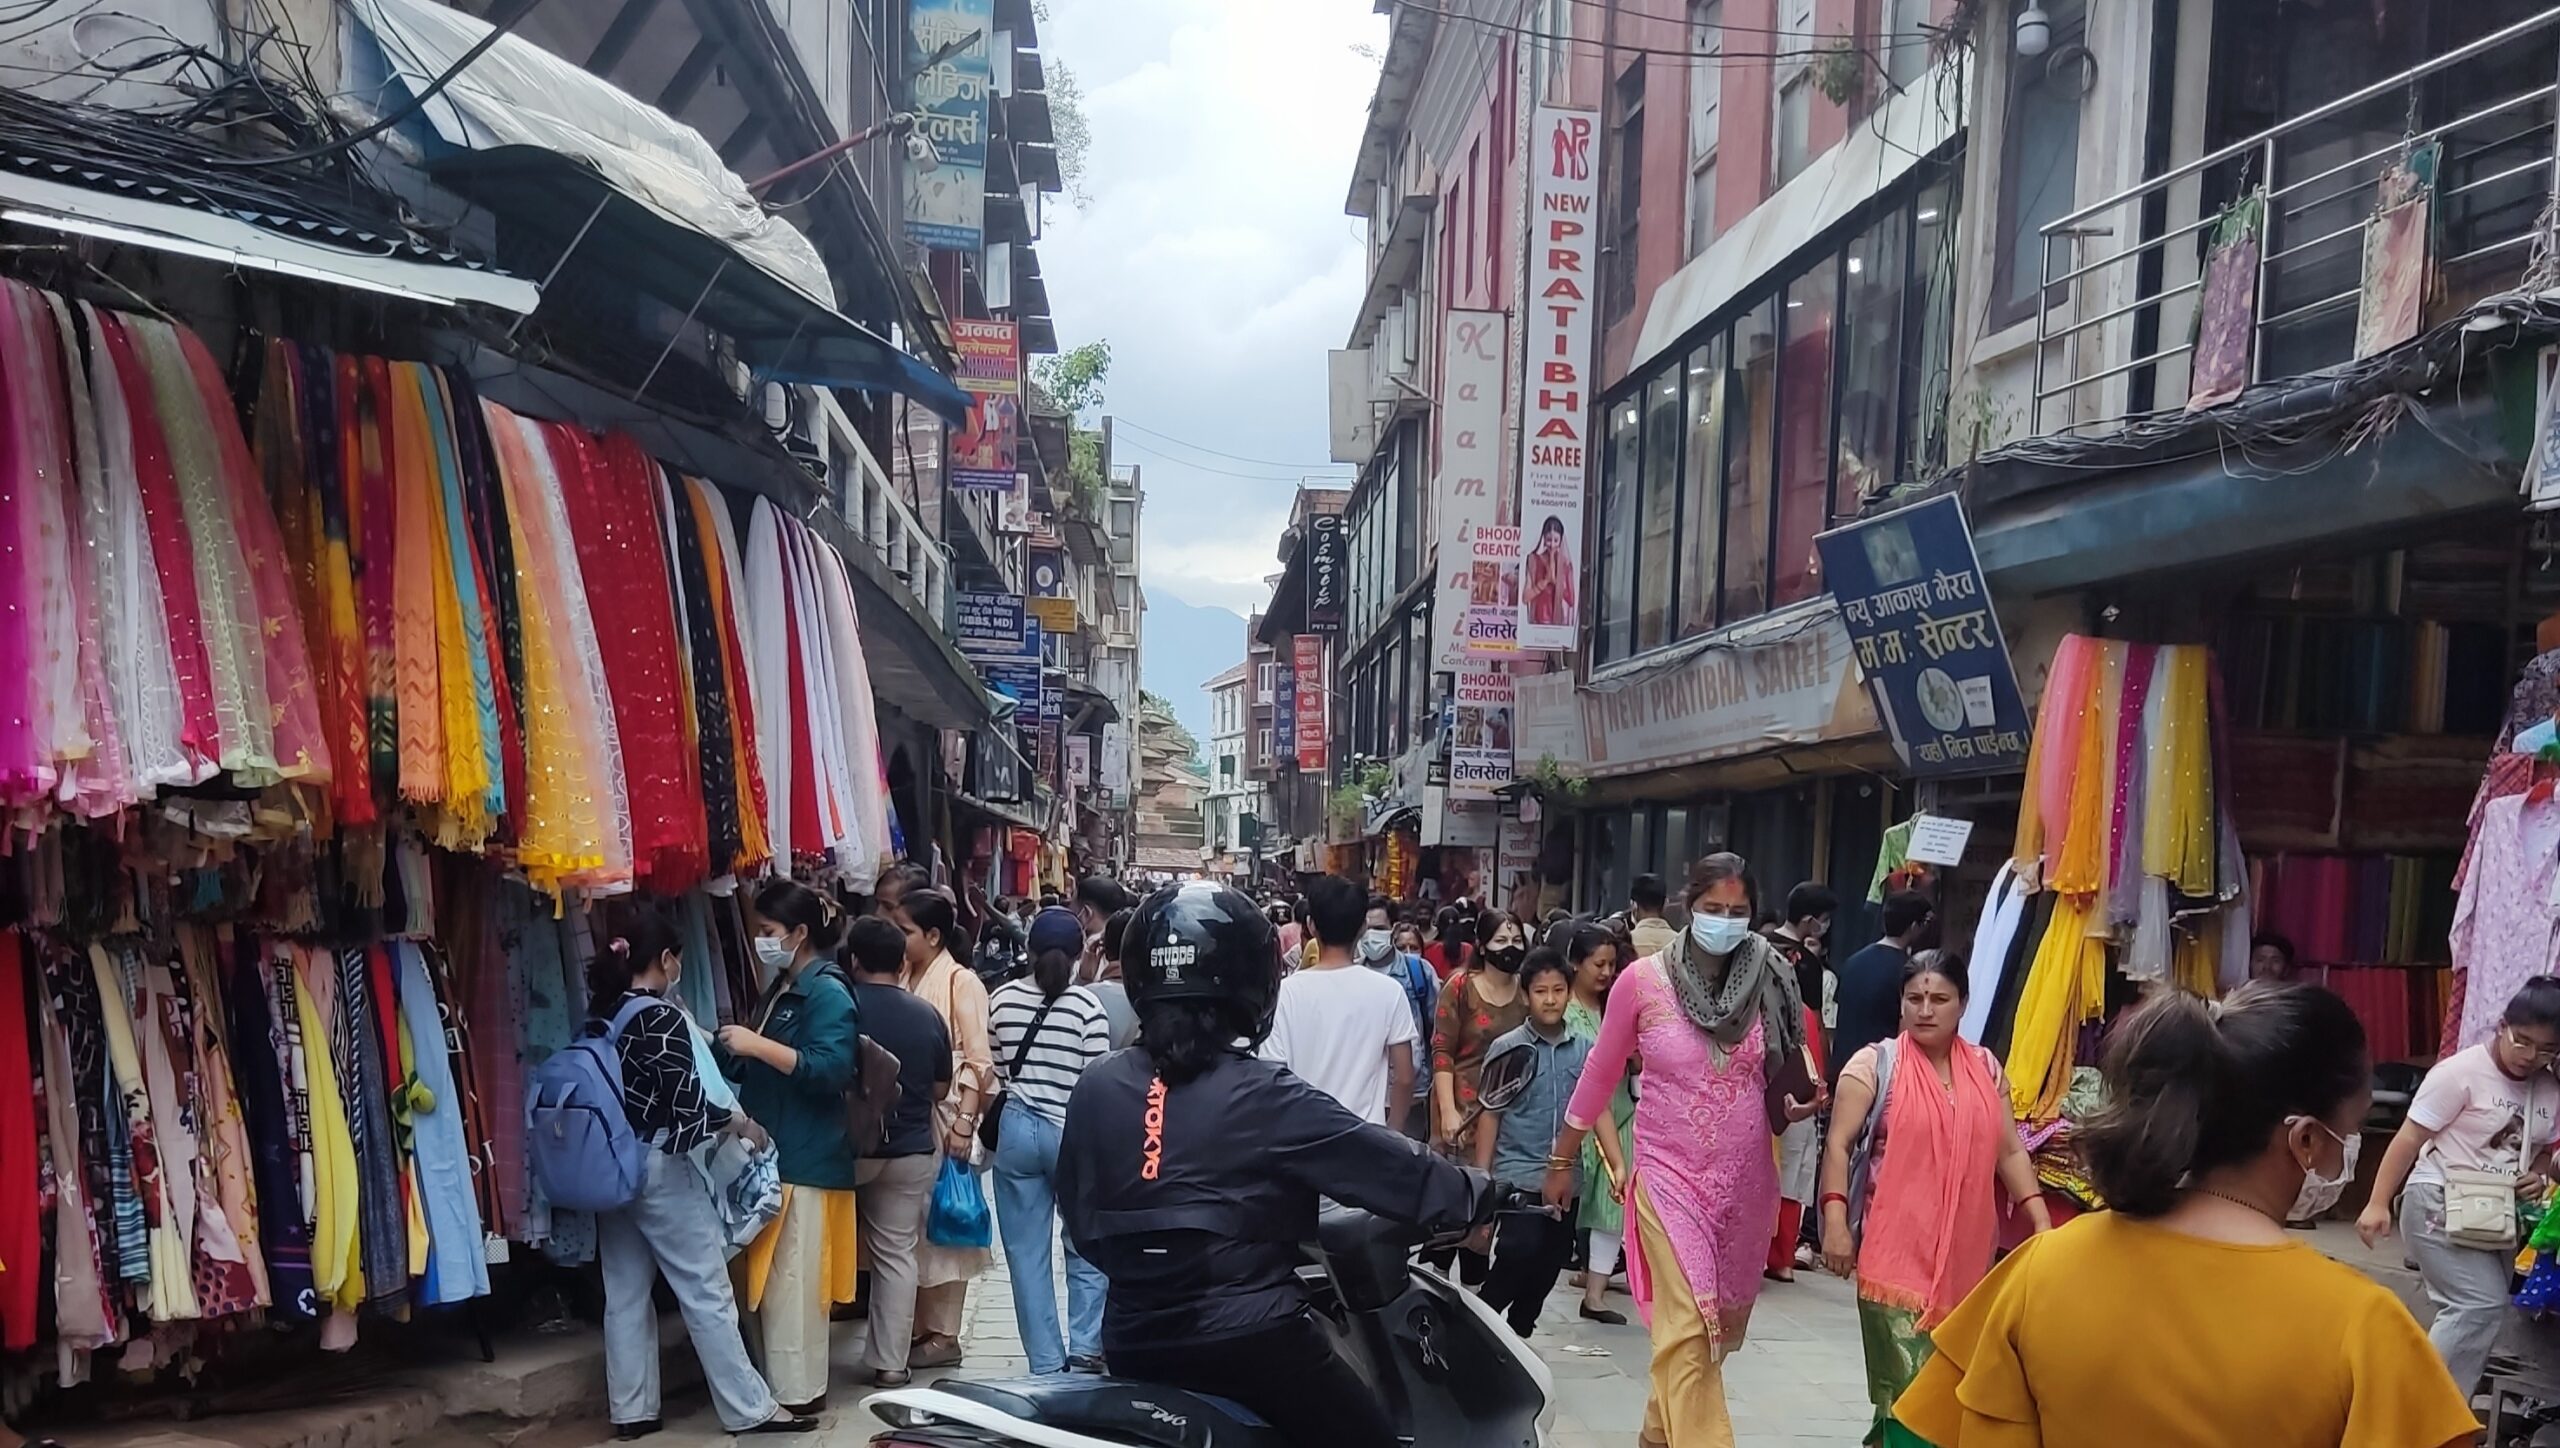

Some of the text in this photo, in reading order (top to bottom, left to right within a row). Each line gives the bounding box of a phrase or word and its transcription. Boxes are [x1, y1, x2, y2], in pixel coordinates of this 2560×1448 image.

[1544, 192, 1590, 214] NEW
[955, 322, 1013, 340] जन्नत
[1536, 220, 1585, 440] PRATIBHA
[1531, 445, 1581, 467] SAREE
[1870, 579, 1932, 618] आकाश
[1932, 568, 1976, 601] भैरव
[1914, 609, 1995, 661] सेन्टर
[1461, 673, 1511, 687] BHOOMI
[1606, 685, 1645, 732] NEW
[1652, 656, 1749, 723] PRATIBHA
[1752, 631, 1830, 699] SAREE
[1457, 687, 1514, 702] CREATION
[1453, 760, 1510, 781] होलसेल
[1150, 945, 1195, 967] STUDDS
